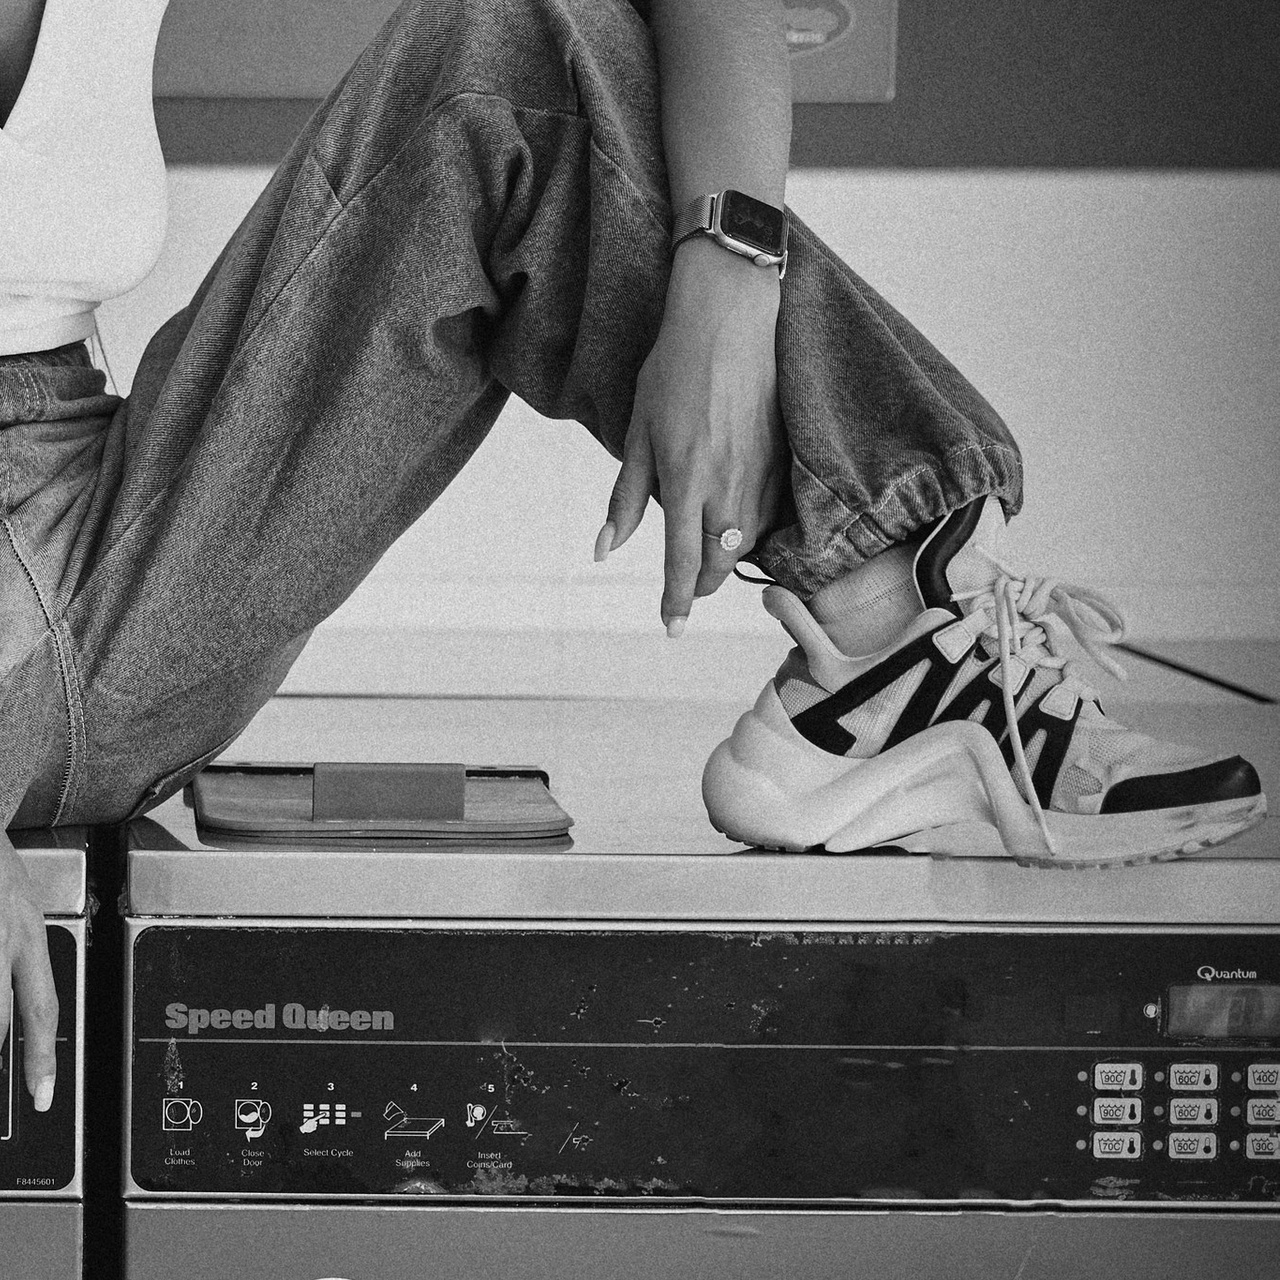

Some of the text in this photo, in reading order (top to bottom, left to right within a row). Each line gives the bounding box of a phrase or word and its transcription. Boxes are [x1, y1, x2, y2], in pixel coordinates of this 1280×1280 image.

[1197, 965, 1257, 981] Quantum
[165, 1003, 394, 1035] Speed Queen
[1104, 1074, 1123, 1084] 90C
[1178, 1074, 1197, 1084] 60C
[1256, 1074, 1274, 1083] 40C
[178, 1081, 184, 1090] 1
[251, 1082, 258, 1090] 2
[327, 1082, 334, 1090] 3
[410, 1084, 417, 1092] 4
[488, 1084, 495, 1092] 5
[1103, 1108, 1122, 1118] 90C
[1178, 1108, 1197, 1118] 60C
[1256, 1108, 1274, 1118] 40C
[1102, 1142, 1121, 1151] 70C
[1177, 1142, 1196, 1151] 50C
[1255, 1142, 1274, 1151] 30C
[241, 1149, 264, 1157] Close
[303, 1149, 354, 1160] Select Cycle
[404, 1150, 421, 1158] Add
[478, 1151, 500, 1159] Insert
[164, 1157, 195, 1166] Clothes
[243, 1158, 263, 1167] Door
[395, 1158, 430, 1169] Supplies
[467, 1160, 512, 1169] Coins/Card
